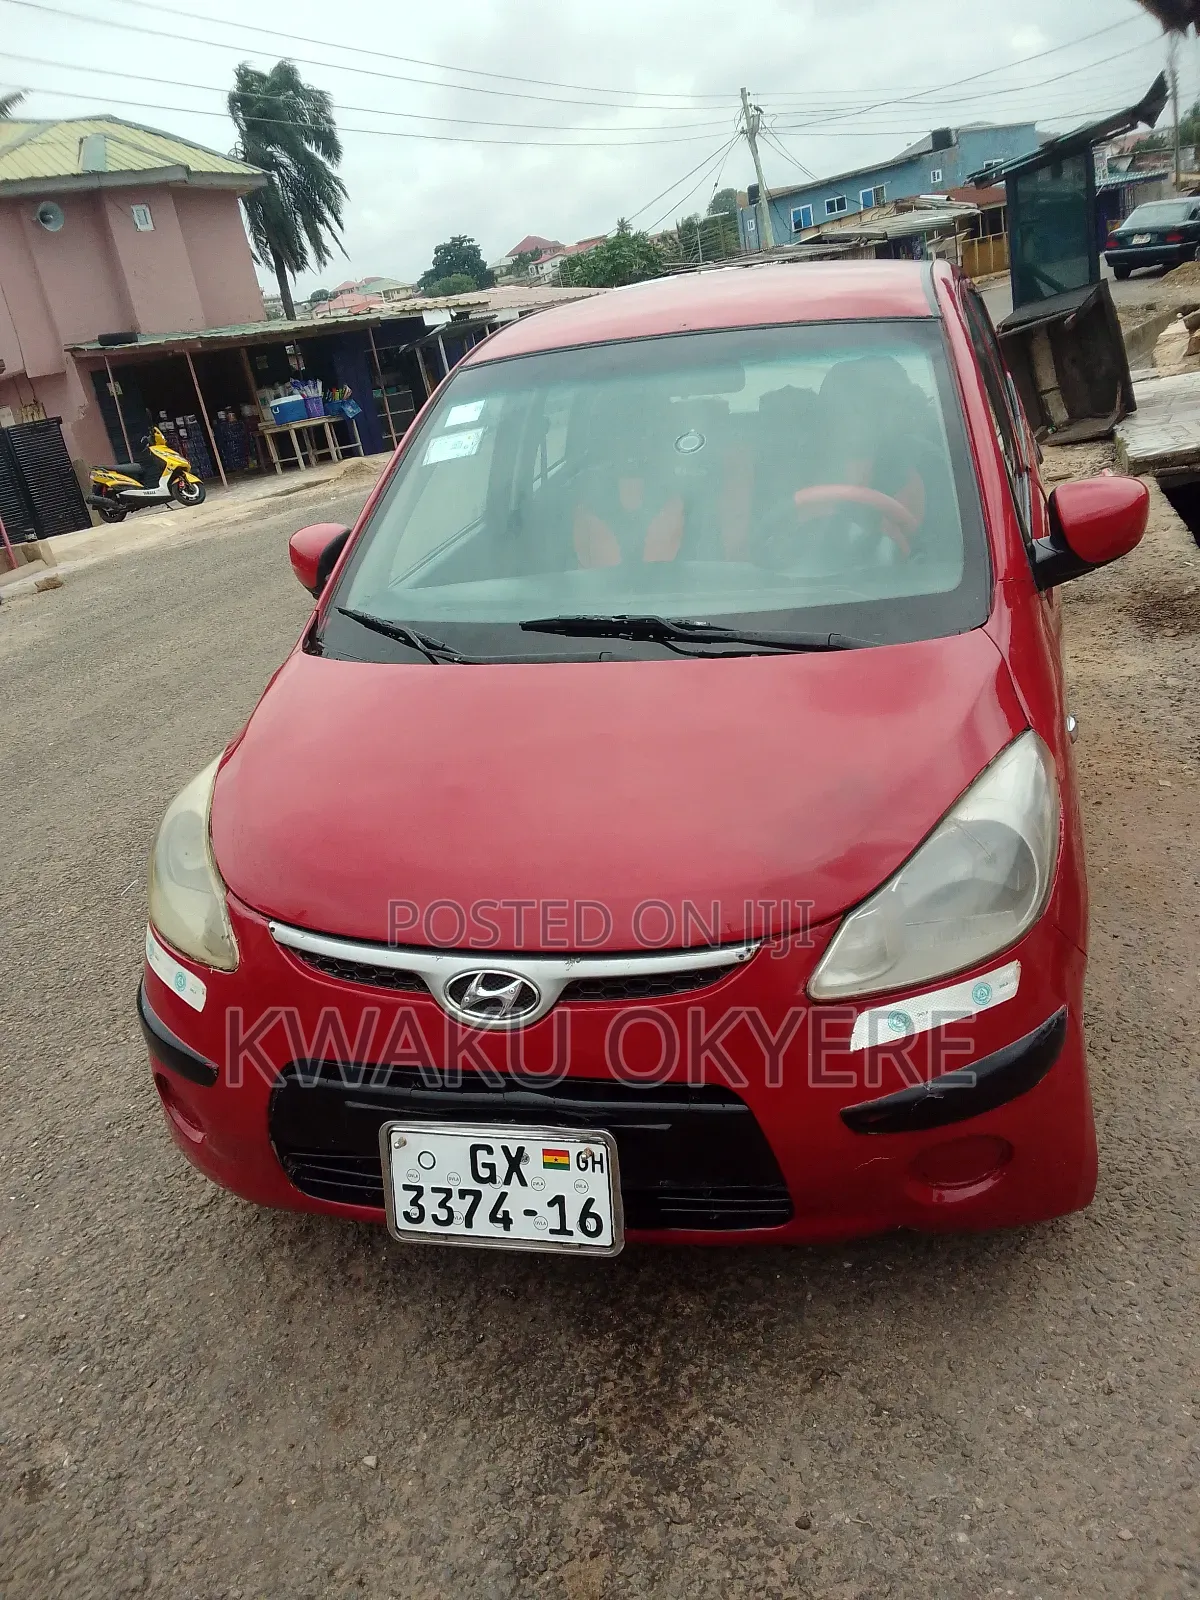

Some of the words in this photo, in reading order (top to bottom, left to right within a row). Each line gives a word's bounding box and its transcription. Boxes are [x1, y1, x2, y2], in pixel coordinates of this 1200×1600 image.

[469, 1143, 528, 1187] GX
[576, 1150, 604, 1174] GH
[402, 1184, 604, 1239] 3374-16
